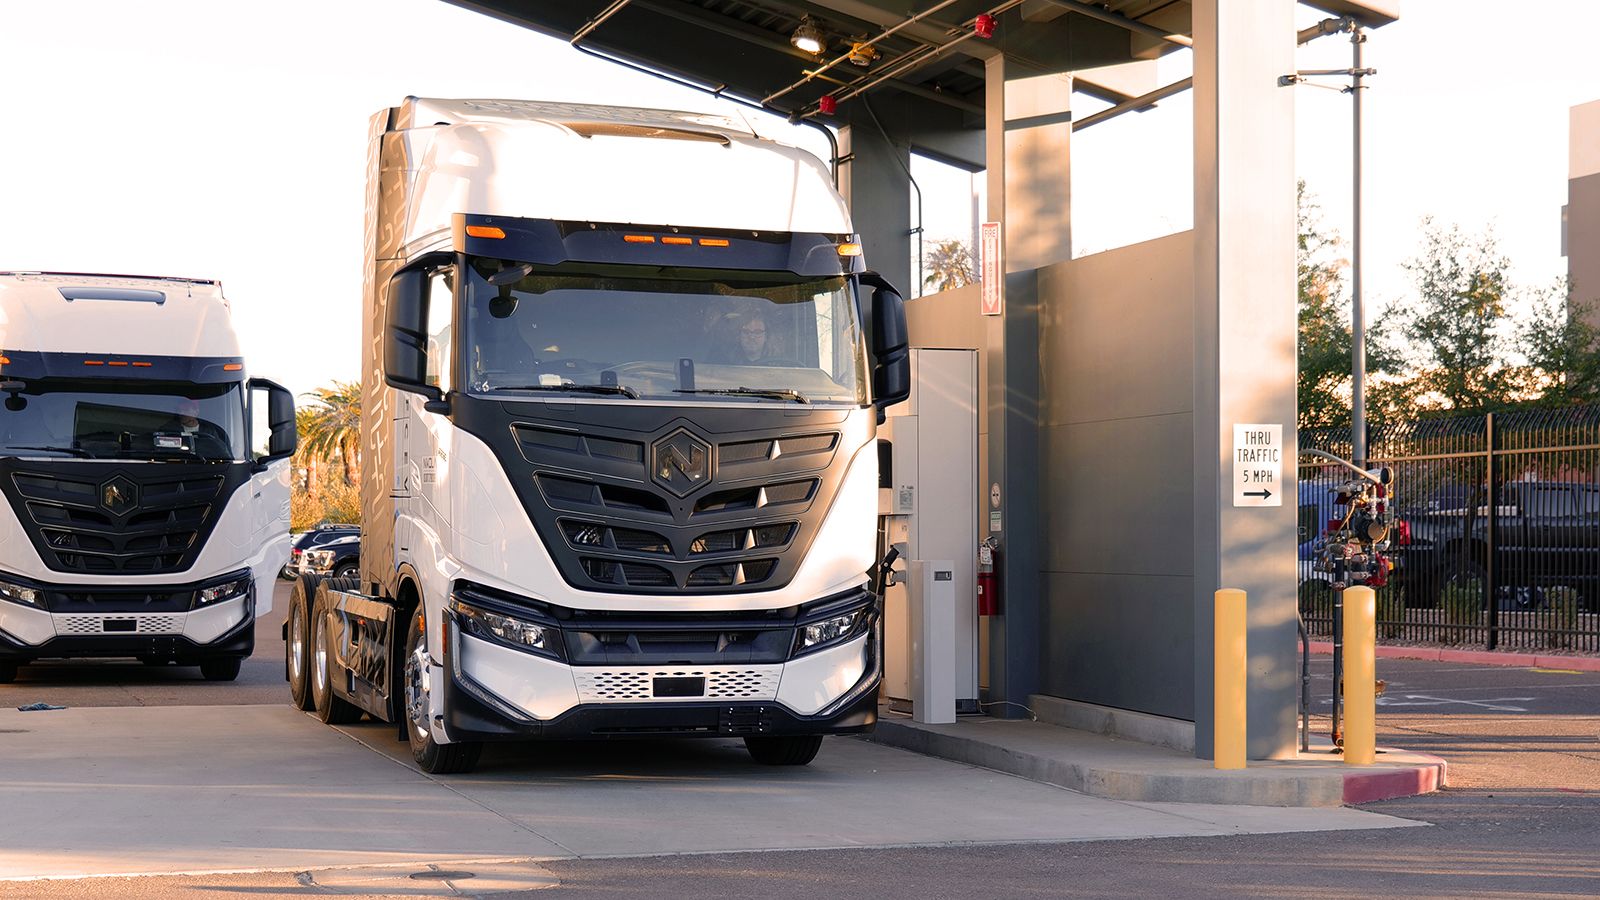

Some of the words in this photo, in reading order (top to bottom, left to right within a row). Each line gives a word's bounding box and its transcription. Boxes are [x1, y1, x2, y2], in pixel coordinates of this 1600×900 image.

[1245, 431, 1271, 445] THRU
[1237, 448, 1279, 462] TRAFFIC
[658, 443, 704, 482] N
[1243, 469, 1249, 483] 5
[1253, 470, 1273, 483] MPH
